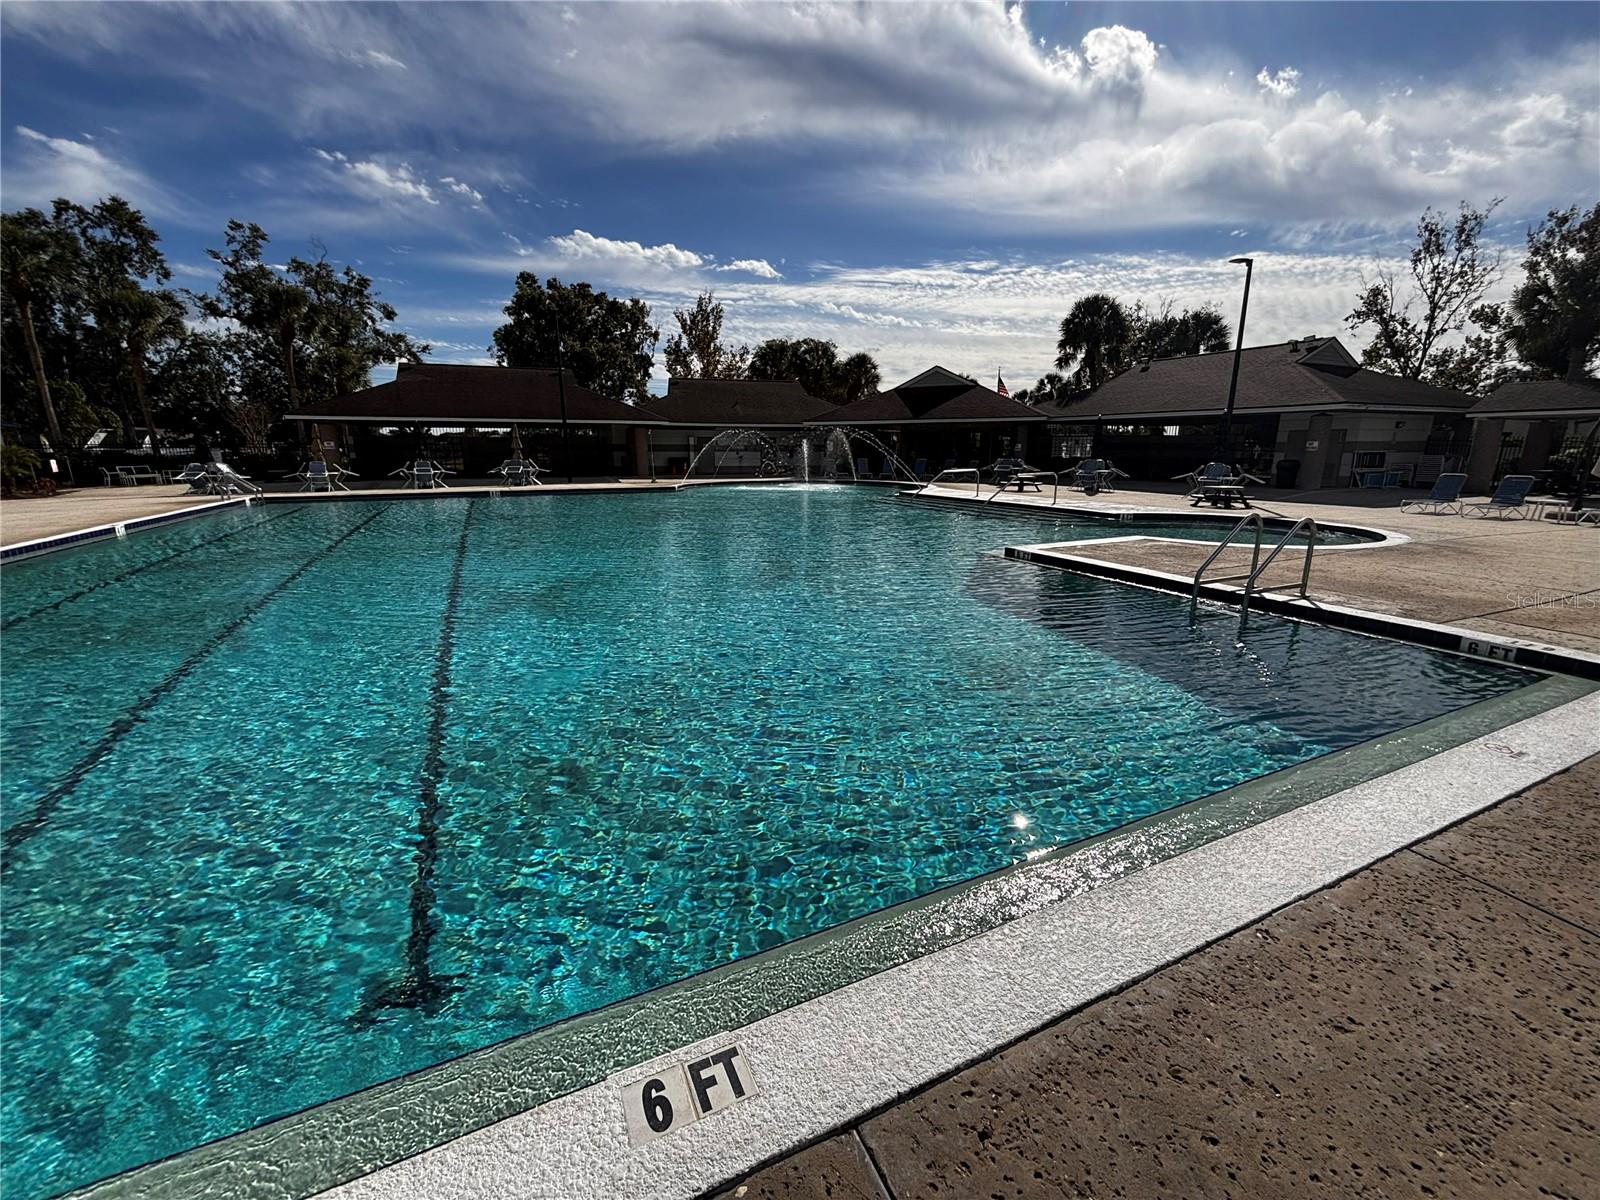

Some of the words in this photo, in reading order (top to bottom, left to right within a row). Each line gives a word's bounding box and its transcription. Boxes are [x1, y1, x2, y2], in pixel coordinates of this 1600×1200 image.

[1468, 641, 1479, 654] 6
[1488, 645, 1513, 661] FT
[642, 1078, 673, 1133] 6
[687, 1046, 746, 1114] FT
